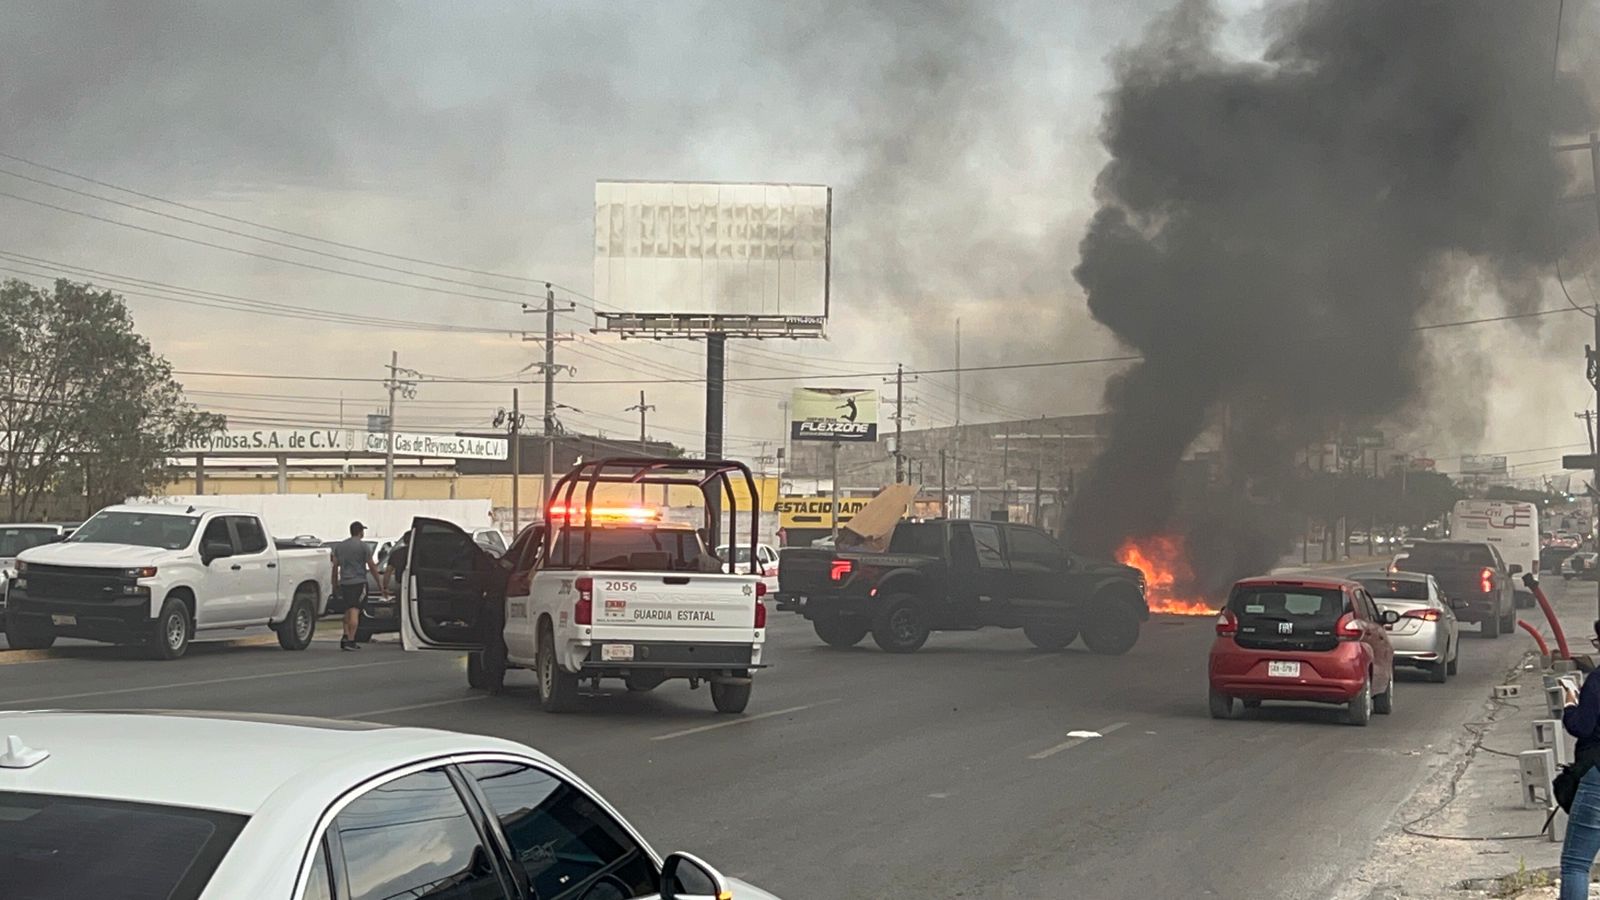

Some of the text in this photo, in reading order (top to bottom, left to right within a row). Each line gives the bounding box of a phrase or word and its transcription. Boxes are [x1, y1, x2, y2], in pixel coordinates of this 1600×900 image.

[800, 422, 869, 433] FLEXZONE
[289, 431, 305, 448] de
[310, 431, 340, 448] C.V.
[395, 434, 412, 451] Gas
[413, 436, 423, 452] de
[774, 502, 868, 513] ESTACIOAM
[605, 581, 637, 591] 2056
[634, 609, 715, 621] GUARDIA ESTATAL
